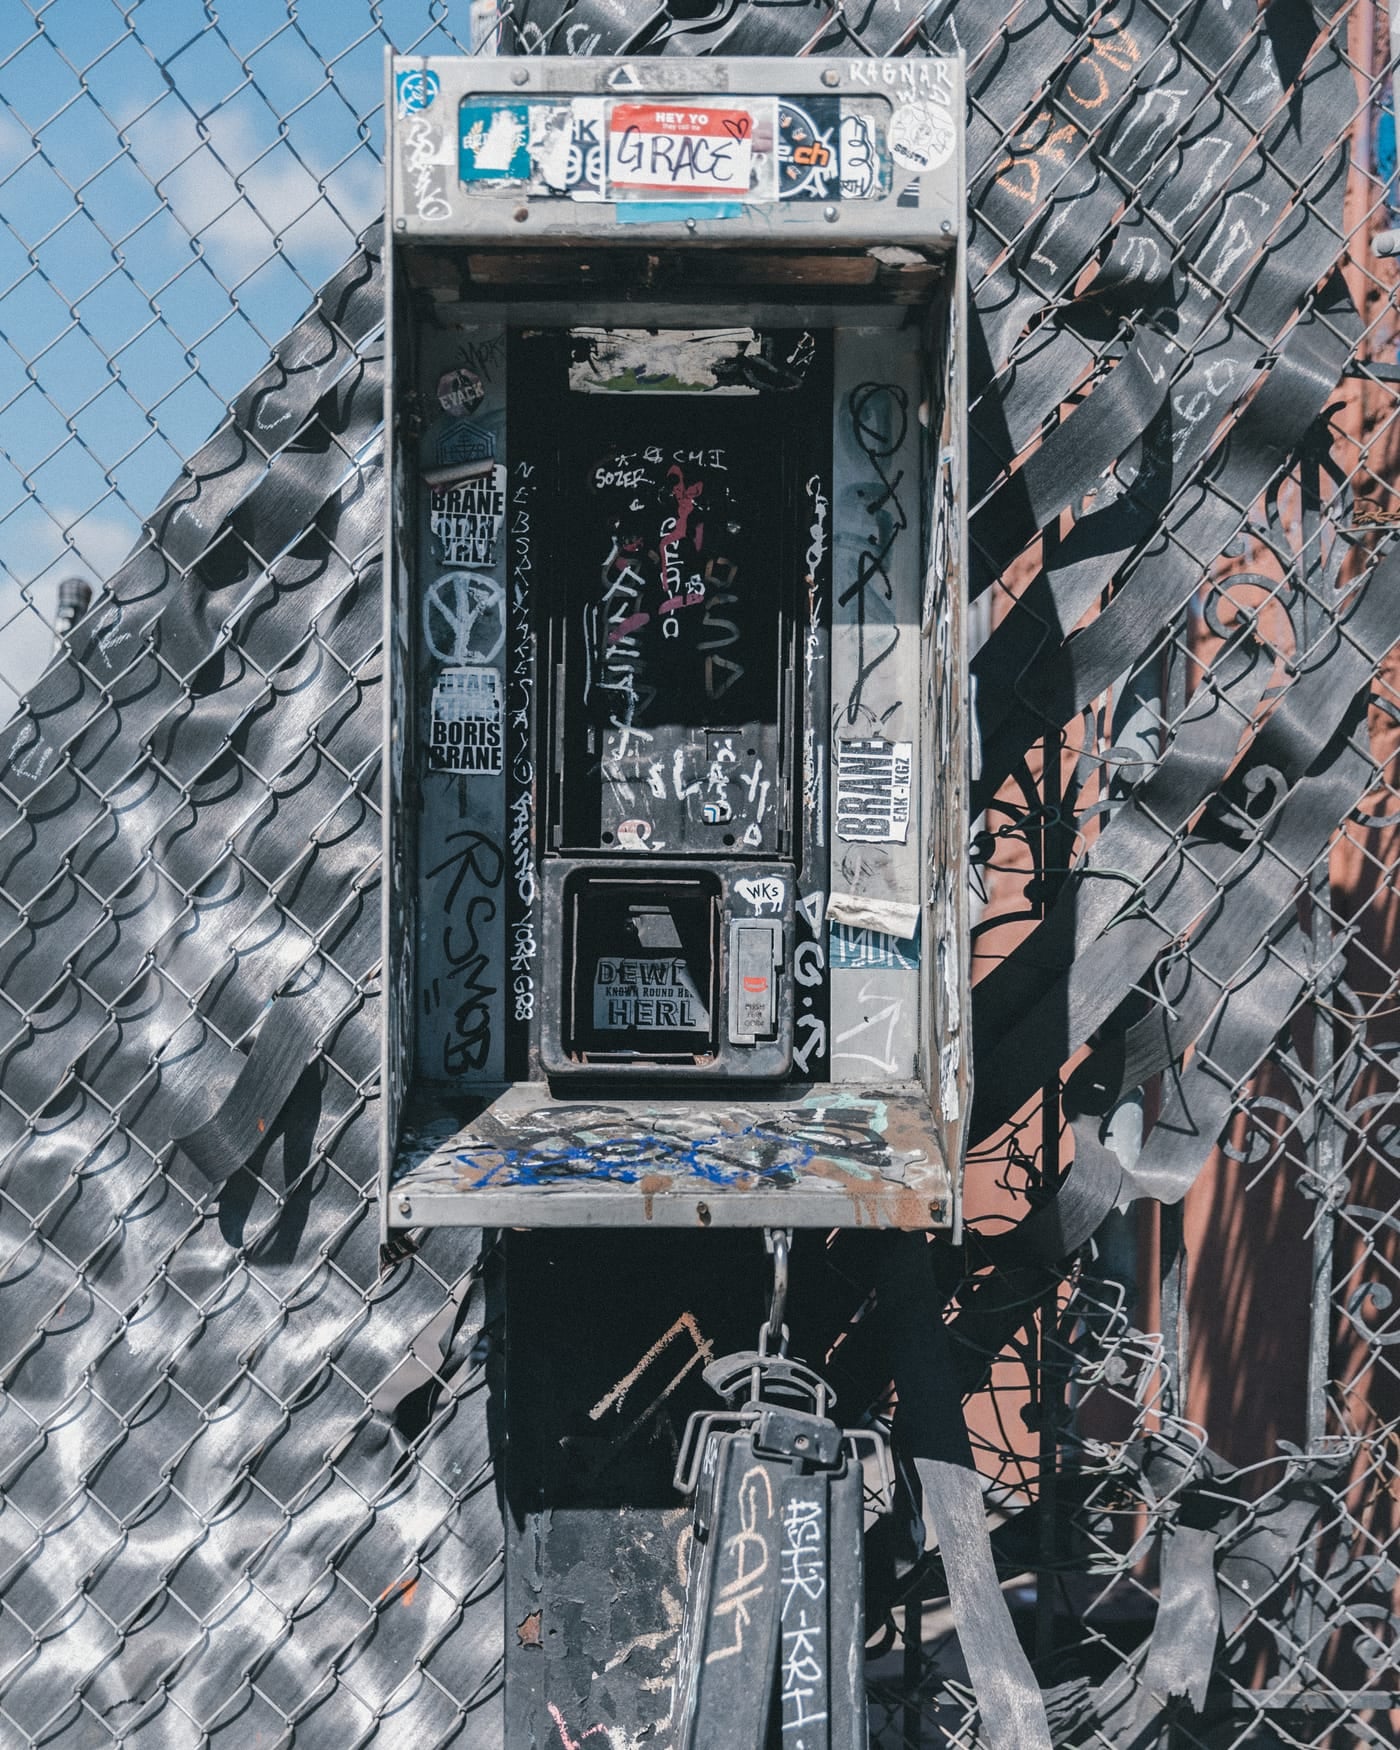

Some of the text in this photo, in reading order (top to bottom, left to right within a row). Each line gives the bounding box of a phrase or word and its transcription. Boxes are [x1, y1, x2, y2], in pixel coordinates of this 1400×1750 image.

[655, 112, 709, 125] HEY YO
[617, 125, 735, 182] GRACE
[431, 489, 504, 516] BRANE
[432, 721, 501, 746] BORIS
[429, 745, 502, 770] BRANE
[837, 740, 894, 837] BRANE
[642, 986, 674, 998] ROUND
